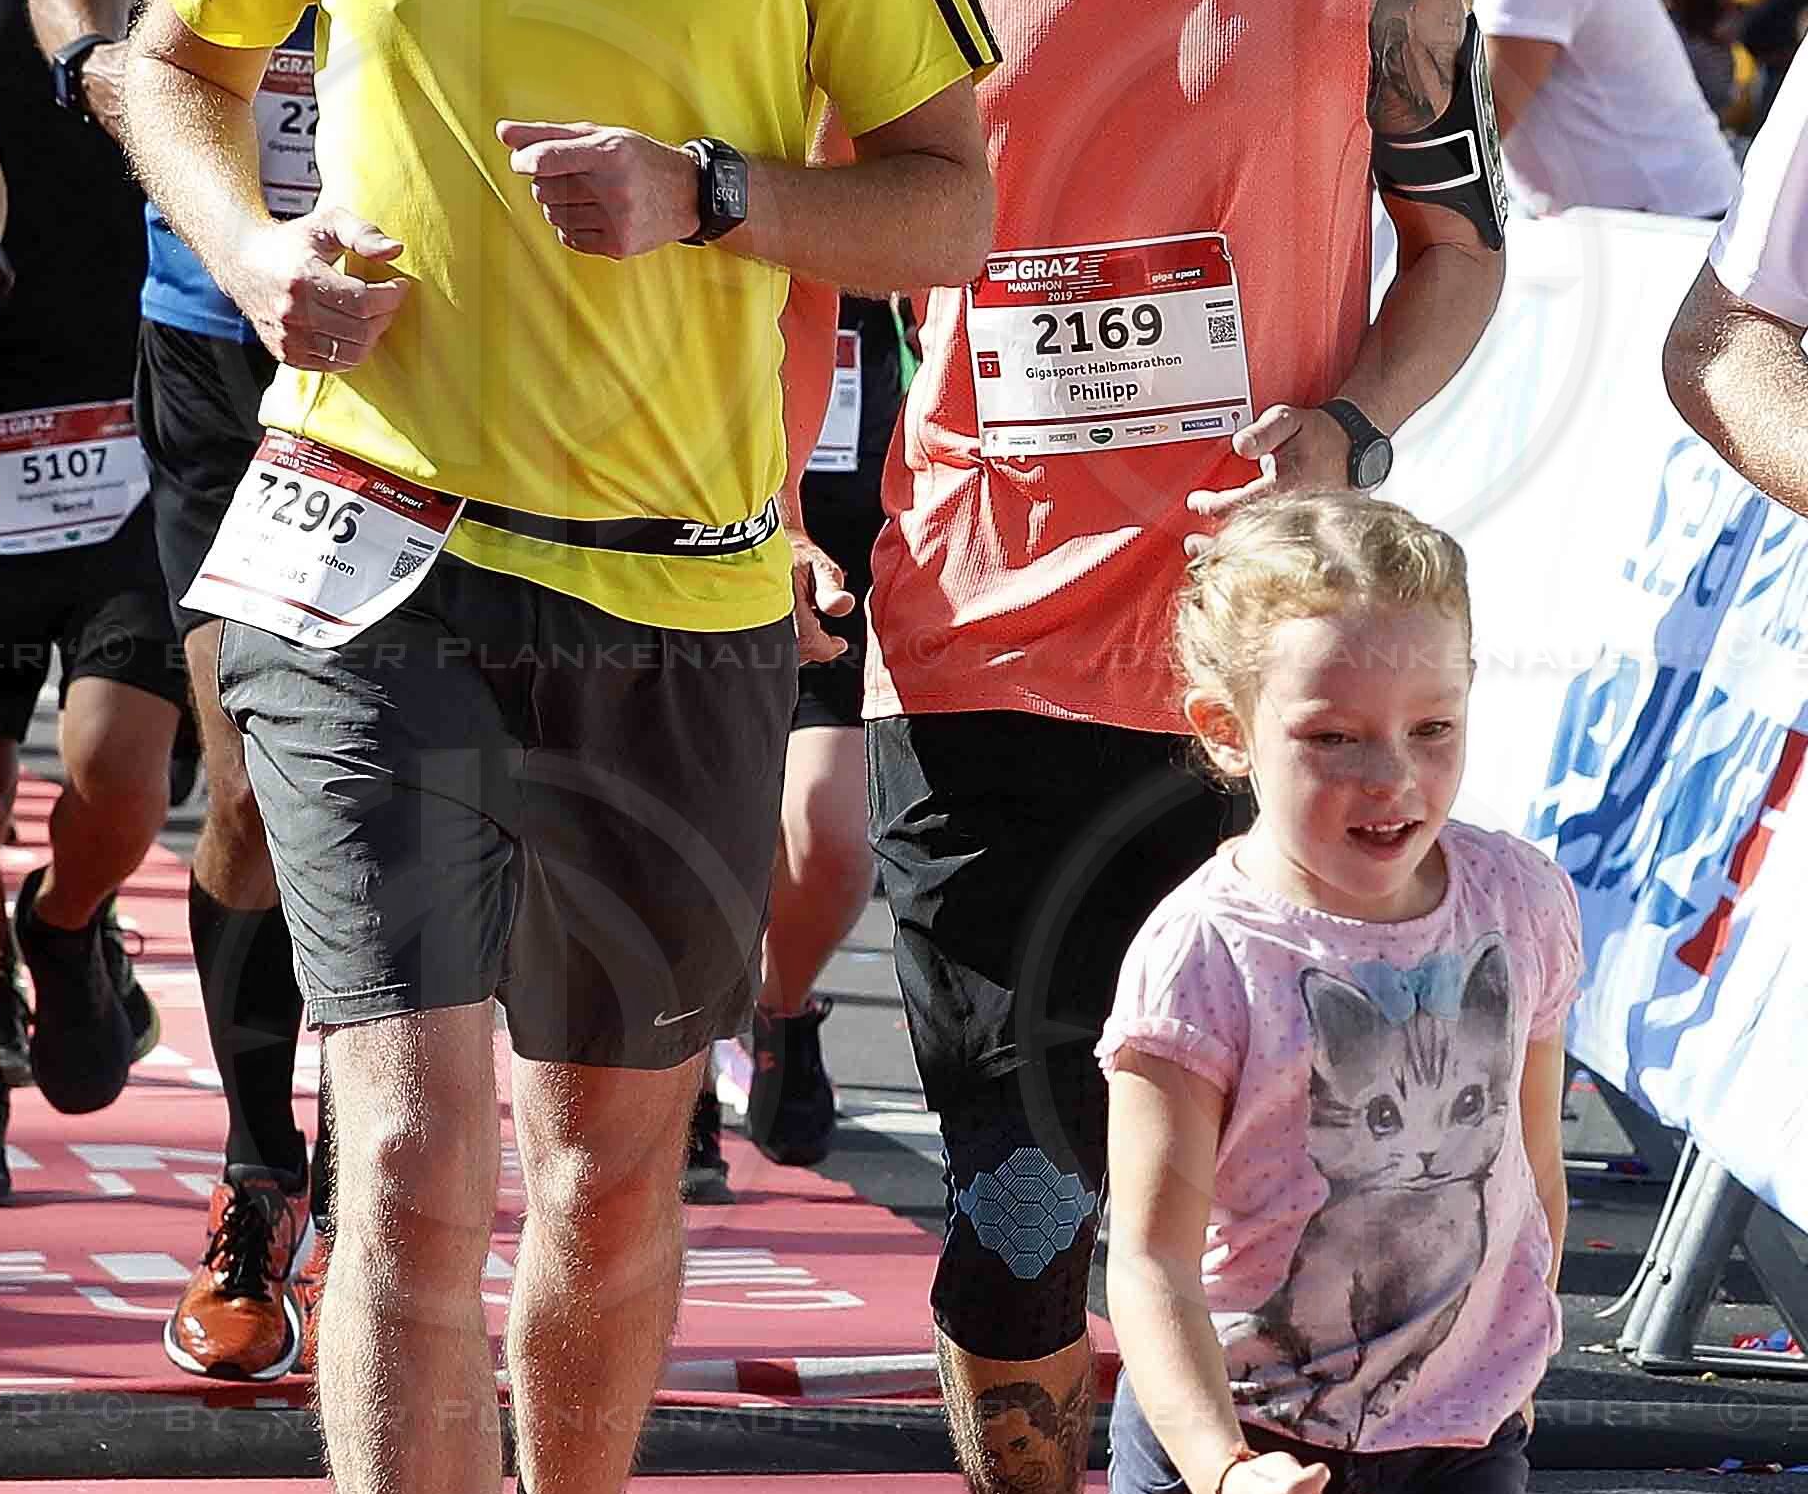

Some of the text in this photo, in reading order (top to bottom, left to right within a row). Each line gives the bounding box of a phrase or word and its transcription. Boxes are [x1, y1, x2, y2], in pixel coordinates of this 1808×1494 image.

[1018, 257, 1080, 280] GRAZ
[1007, 280, 1062, 294] MARATHON
[1047, 291, 1073, 303] 2019
[1032, 304, 1164, 356] 2169
[1025, 355, 1182, 380] Gigasport Halbmarathon
[1069, 382, 1139, 404] Philipp
[23, 447, 108, 485] 5107
[259, 472, 367, 545] 7296
